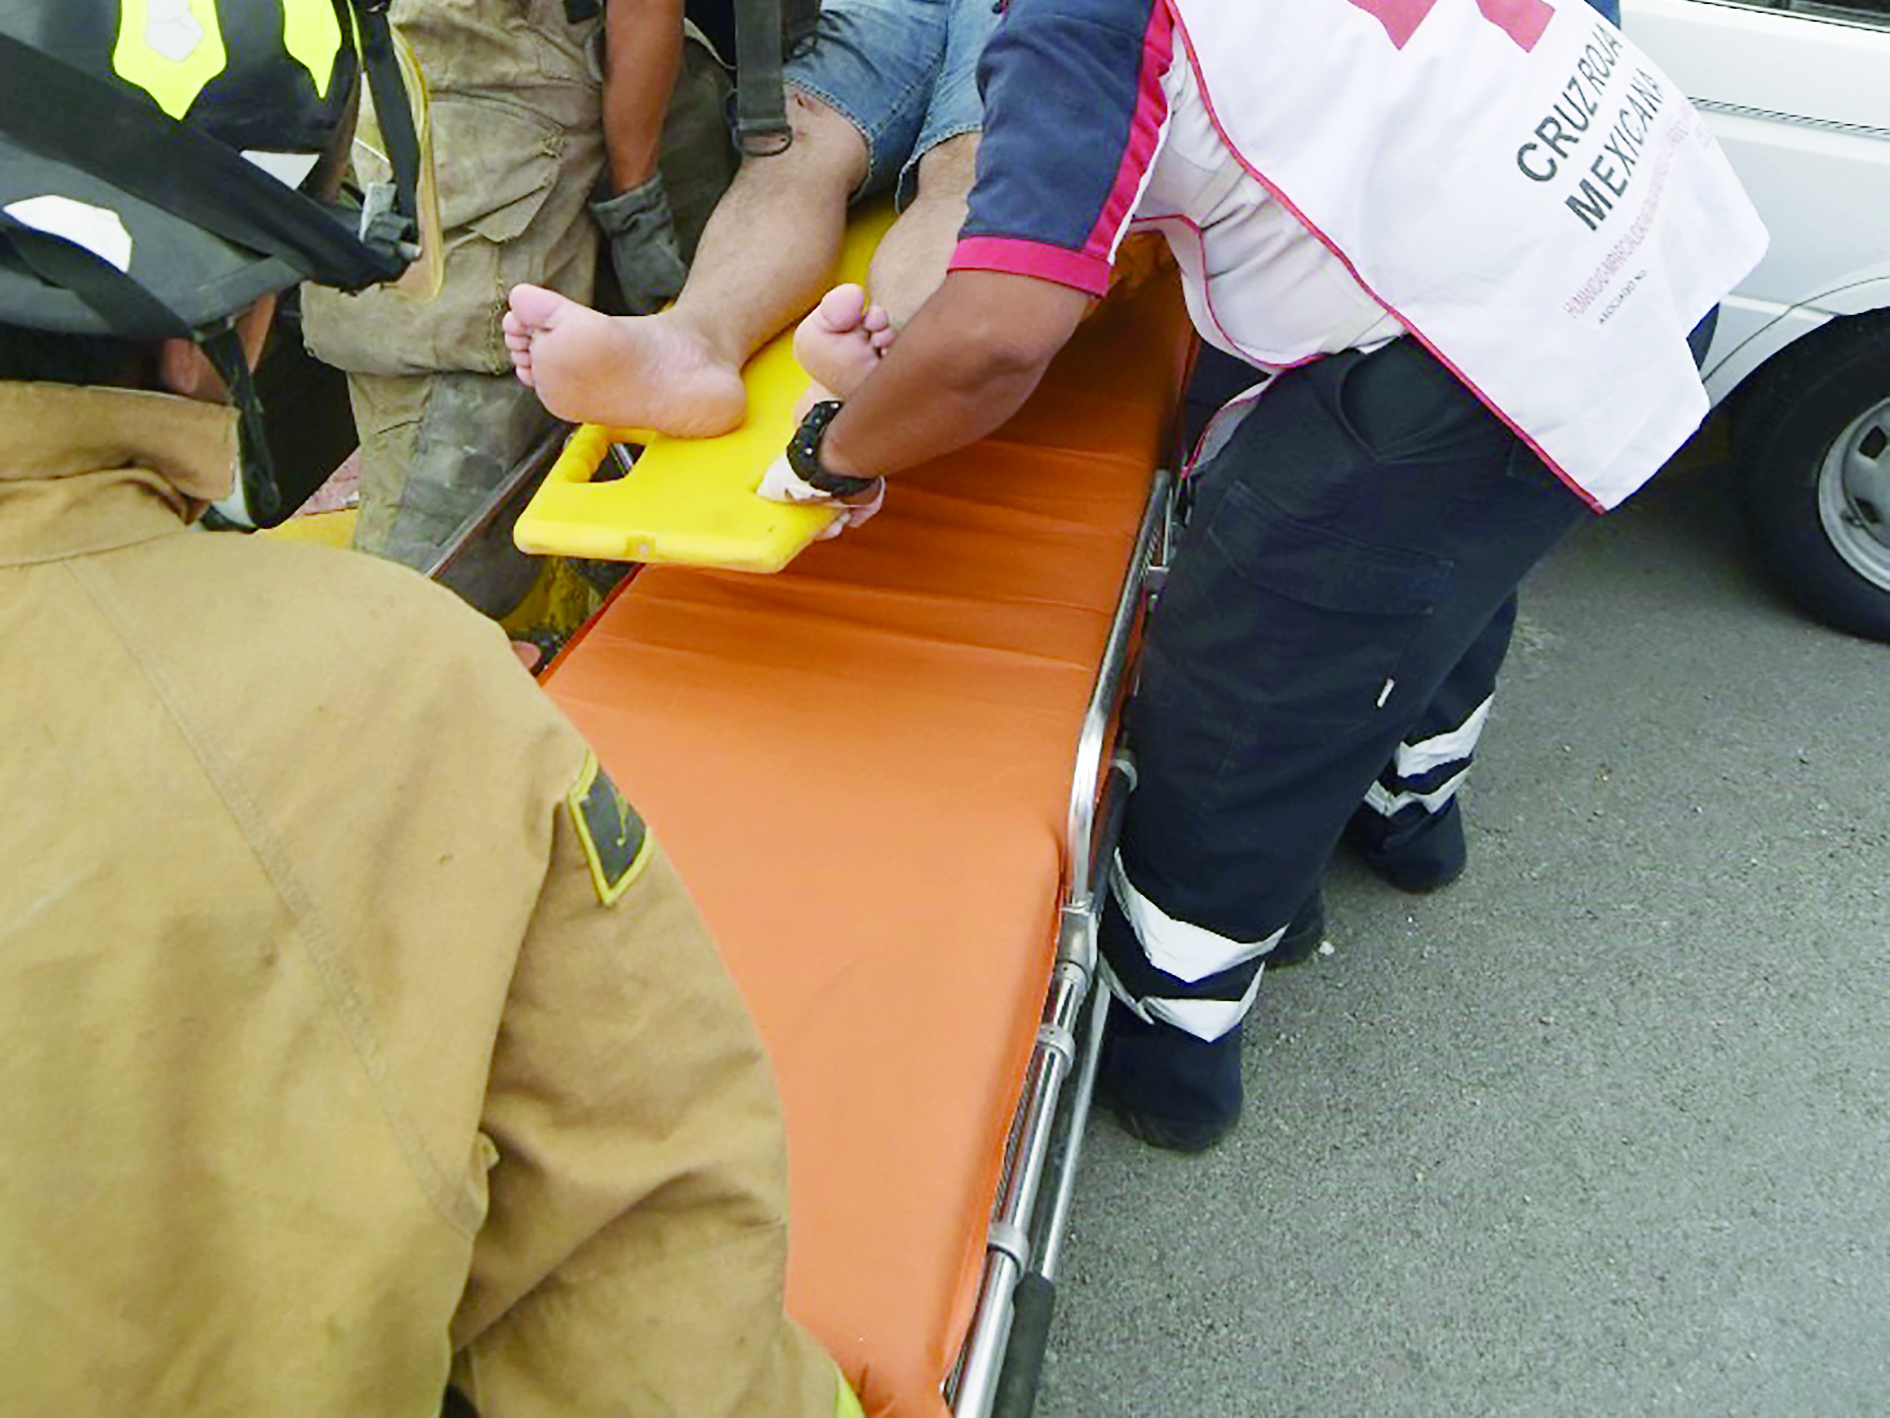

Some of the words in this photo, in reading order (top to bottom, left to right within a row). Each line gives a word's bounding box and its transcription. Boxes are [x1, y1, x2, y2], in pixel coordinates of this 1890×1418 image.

[1516, 76, 1599, 182] CRUZ
[1577, 23, 1624, 96] ROJA
[1564, 67, 1666, 232] MEXICANA
